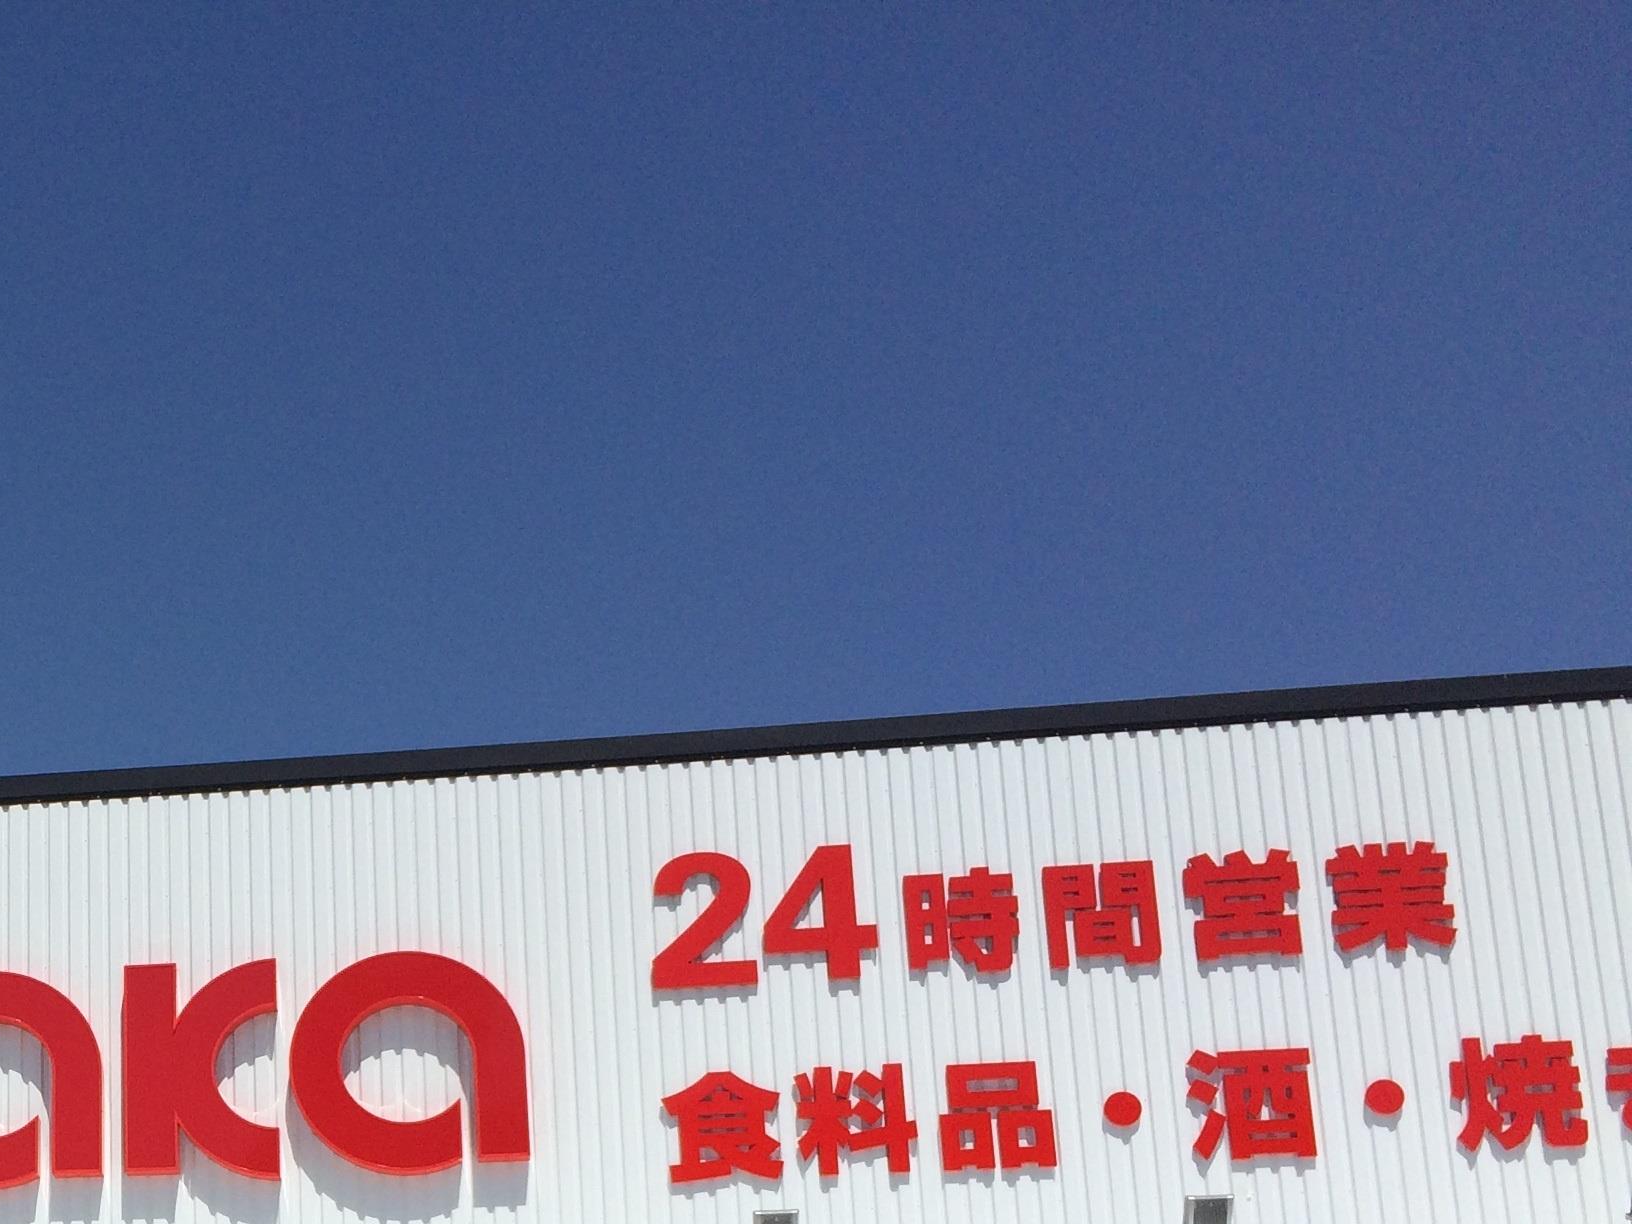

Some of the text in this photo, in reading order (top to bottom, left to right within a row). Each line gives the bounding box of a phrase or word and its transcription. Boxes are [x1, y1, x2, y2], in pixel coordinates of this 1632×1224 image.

[652, 842, 1455, 989] 24時間営業
[663, 1035, 1632, 1182] 食料品・酒・焼
